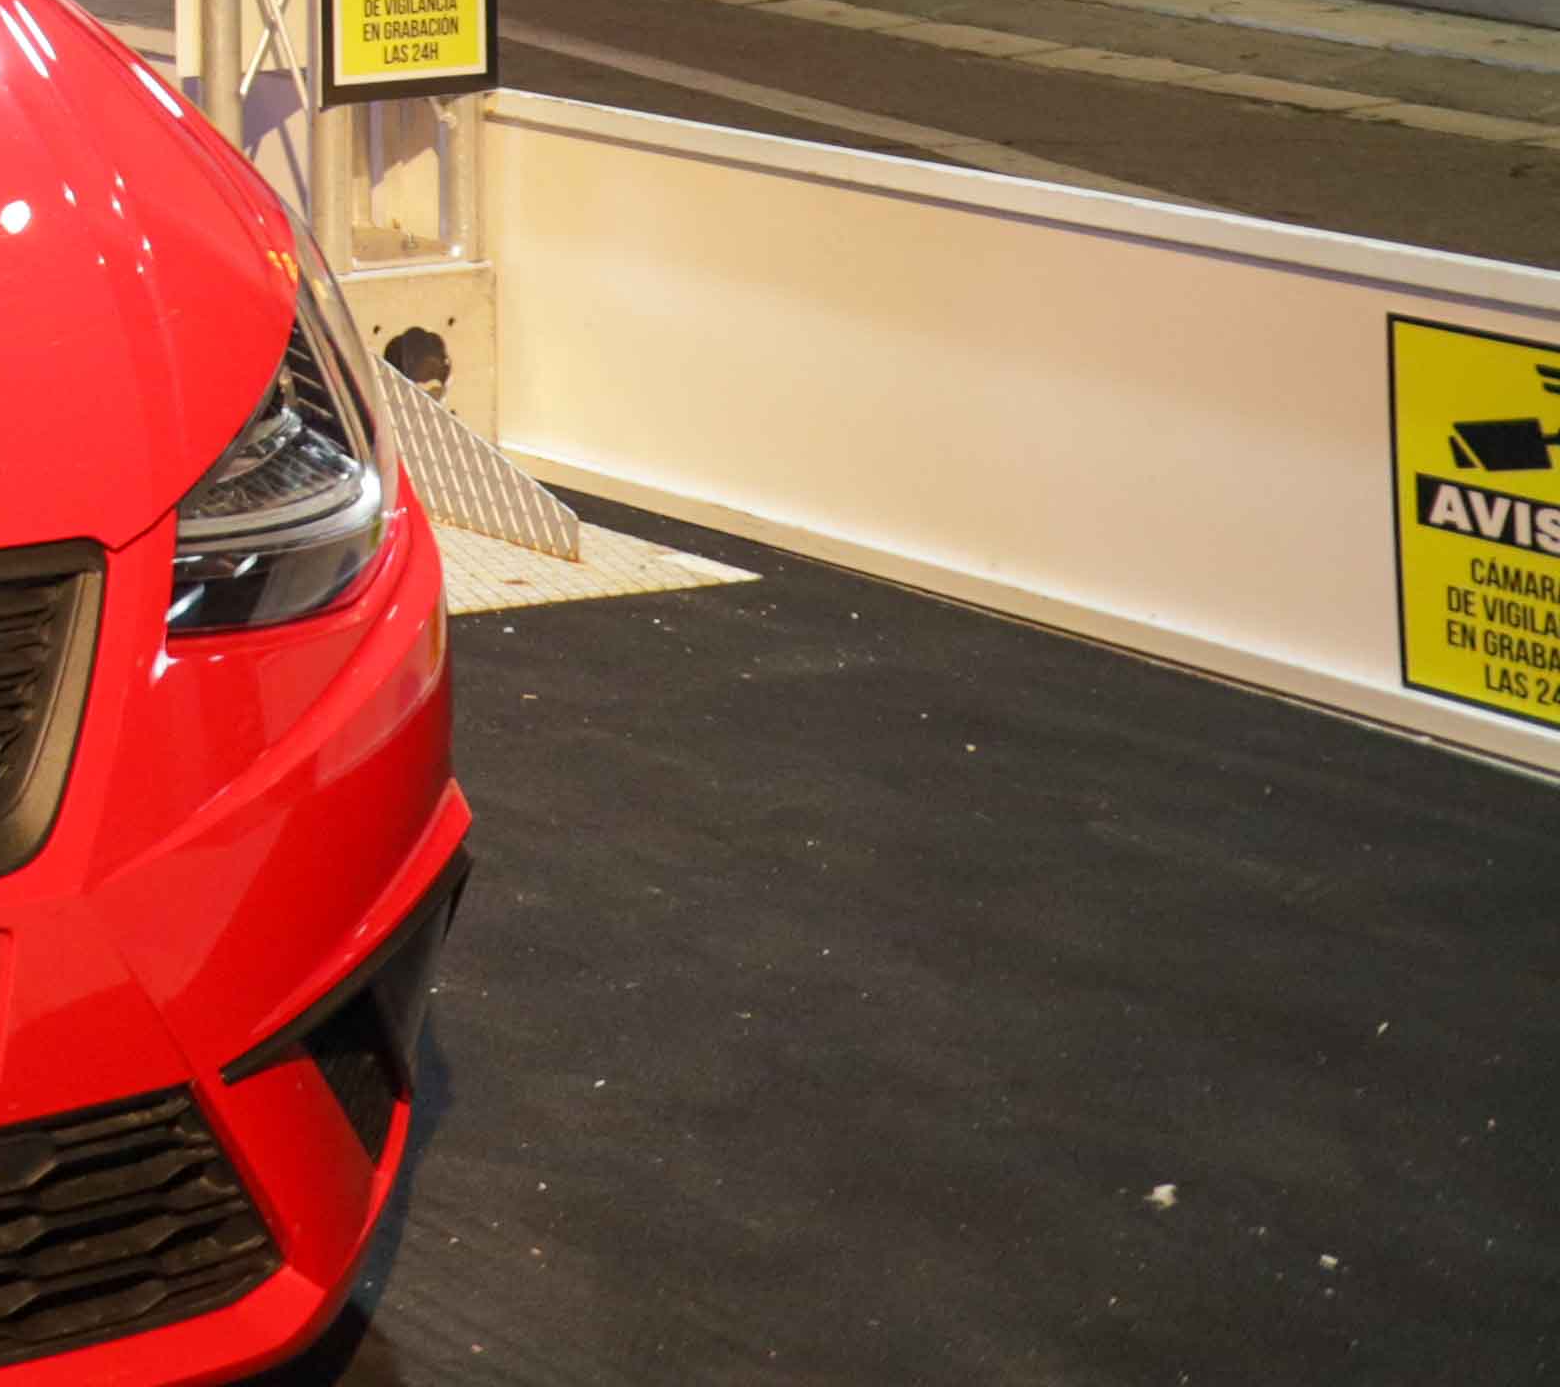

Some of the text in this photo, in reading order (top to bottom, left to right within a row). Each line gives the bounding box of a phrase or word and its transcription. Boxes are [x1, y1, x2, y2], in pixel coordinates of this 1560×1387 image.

[363, 16, 459, 42] EN GRABACIÓN
[384, 42, 439, 65] LAS 24H
[1470, 557, 1560, 604] CÁMAR
[1447, 585, 1476, 617] DE
[1446, 618, 1477, 652] EN
[1485, 663, 1529, 700] LAS
